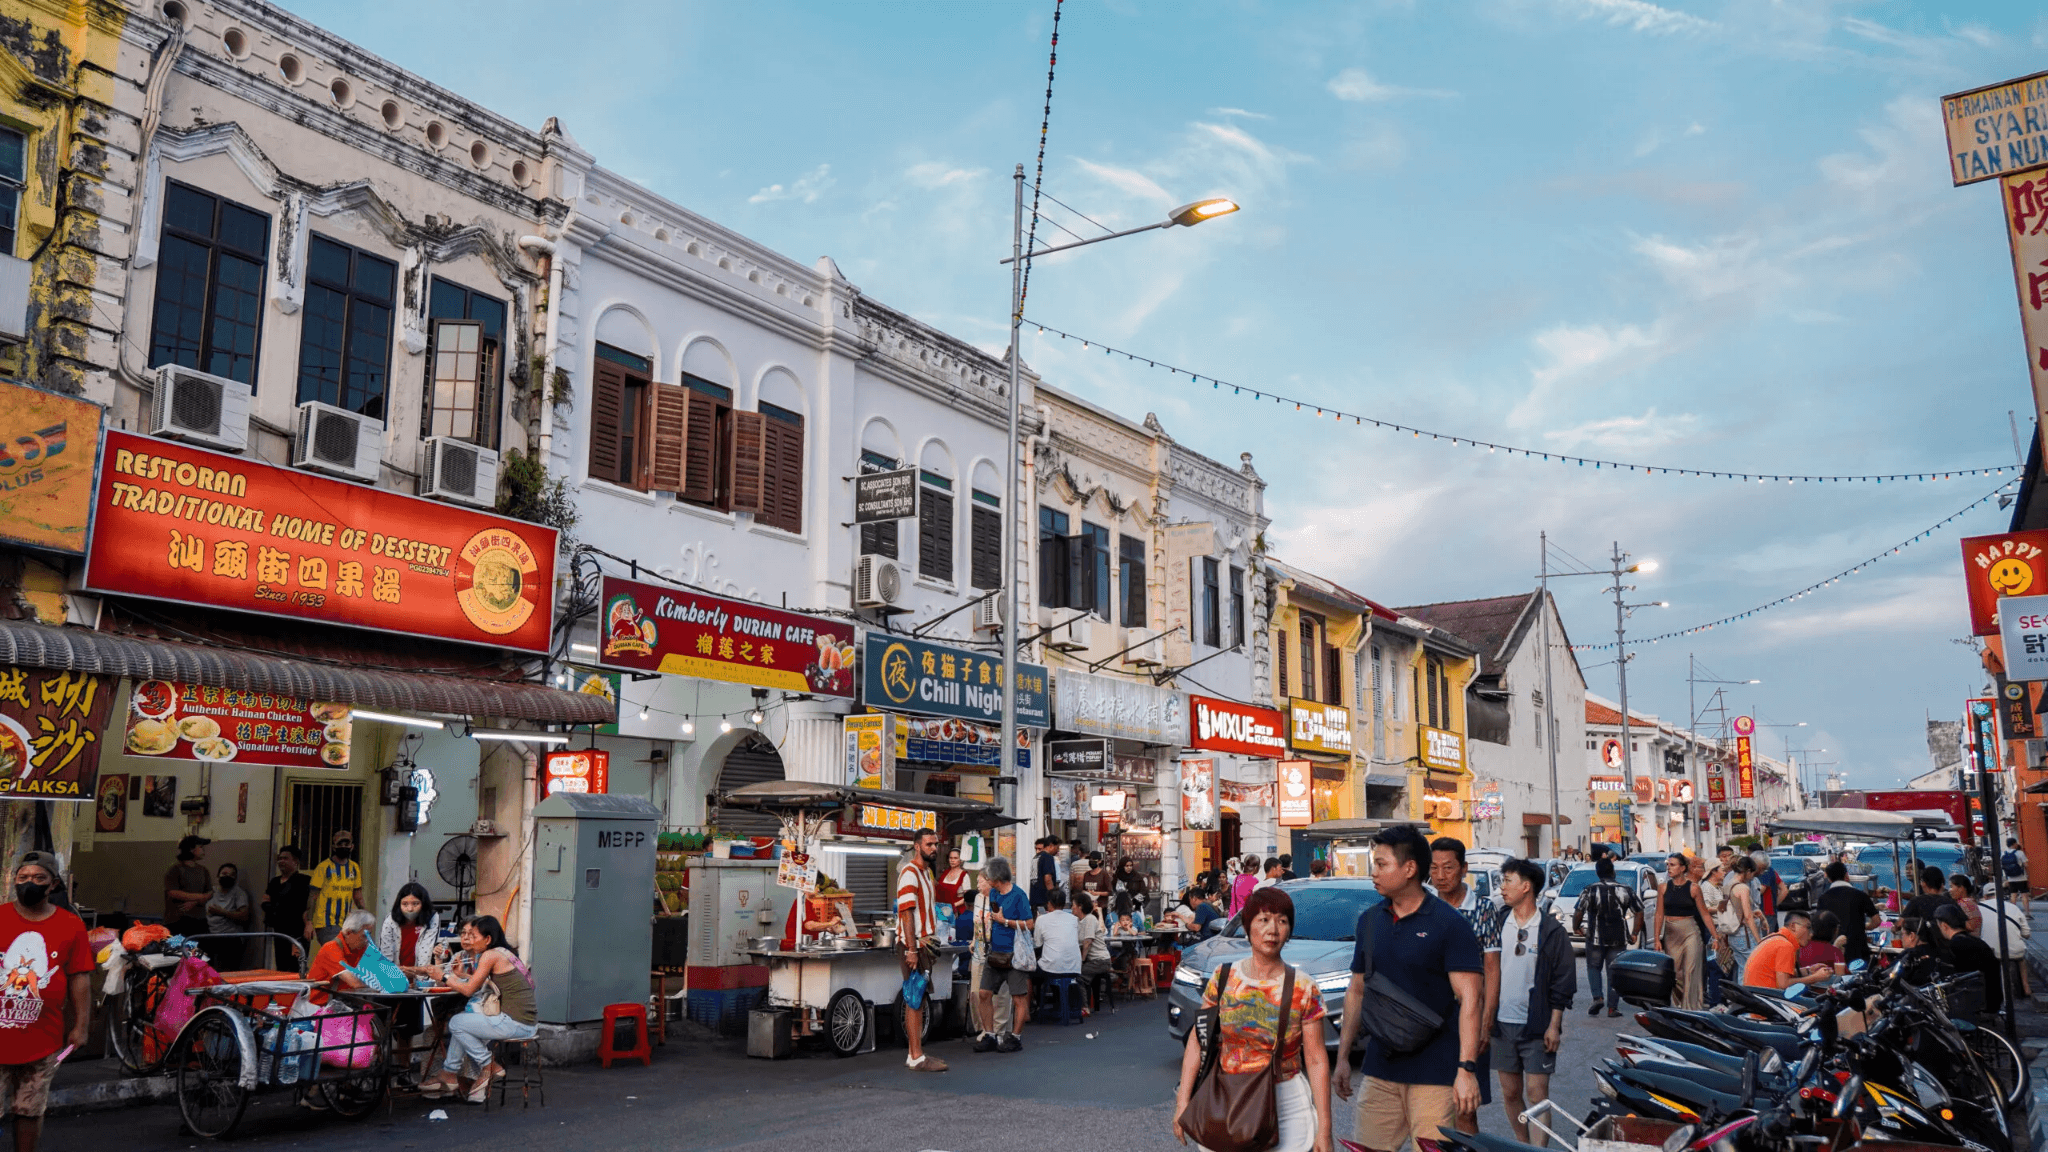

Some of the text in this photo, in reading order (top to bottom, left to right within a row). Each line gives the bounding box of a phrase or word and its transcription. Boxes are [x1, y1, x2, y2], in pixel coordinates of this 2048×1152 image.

[1949, 86, 2020, 120] PERMAINAN
[1957, 145, 2003, 179] TAN
[0, 467, 44, 491] LUS
[115, 448, 247, 498] RESTORAN
[111, 482, 452, 568] TRADITIONAL HOME OF DESSERT
[1975, 540, 2042, 569] HAPPY
[254, 584, 327, 608] Since 1933
[655, 595, 815, 646] Kimberly DURIAN CAFE
[888, 654, 911, 692] 夜
[920, 677, 1003, 716] Chill Nigh
[1017, 692, 1032, 706] 头街
[182, 703, 302, 723] Authentic Hainan Chicken
[1017, 707, 1044, 718] estaurant
[1211, 709, 1255, 743] MIXUE
[237, 741, 317, 755] Signature Porridge
[1708, 763, 1723, 774] 4D
[16, 779, 79, 794] LAKSA
[1591, 780, 1626, 791] BEUTEA
[1598, 801, 1620, 811] GAS
[598, 831, 645, 848] MBPP
[13, 999, 44, 1011] YOUR
[1197, 1014, 1208, 1047] LIKE
